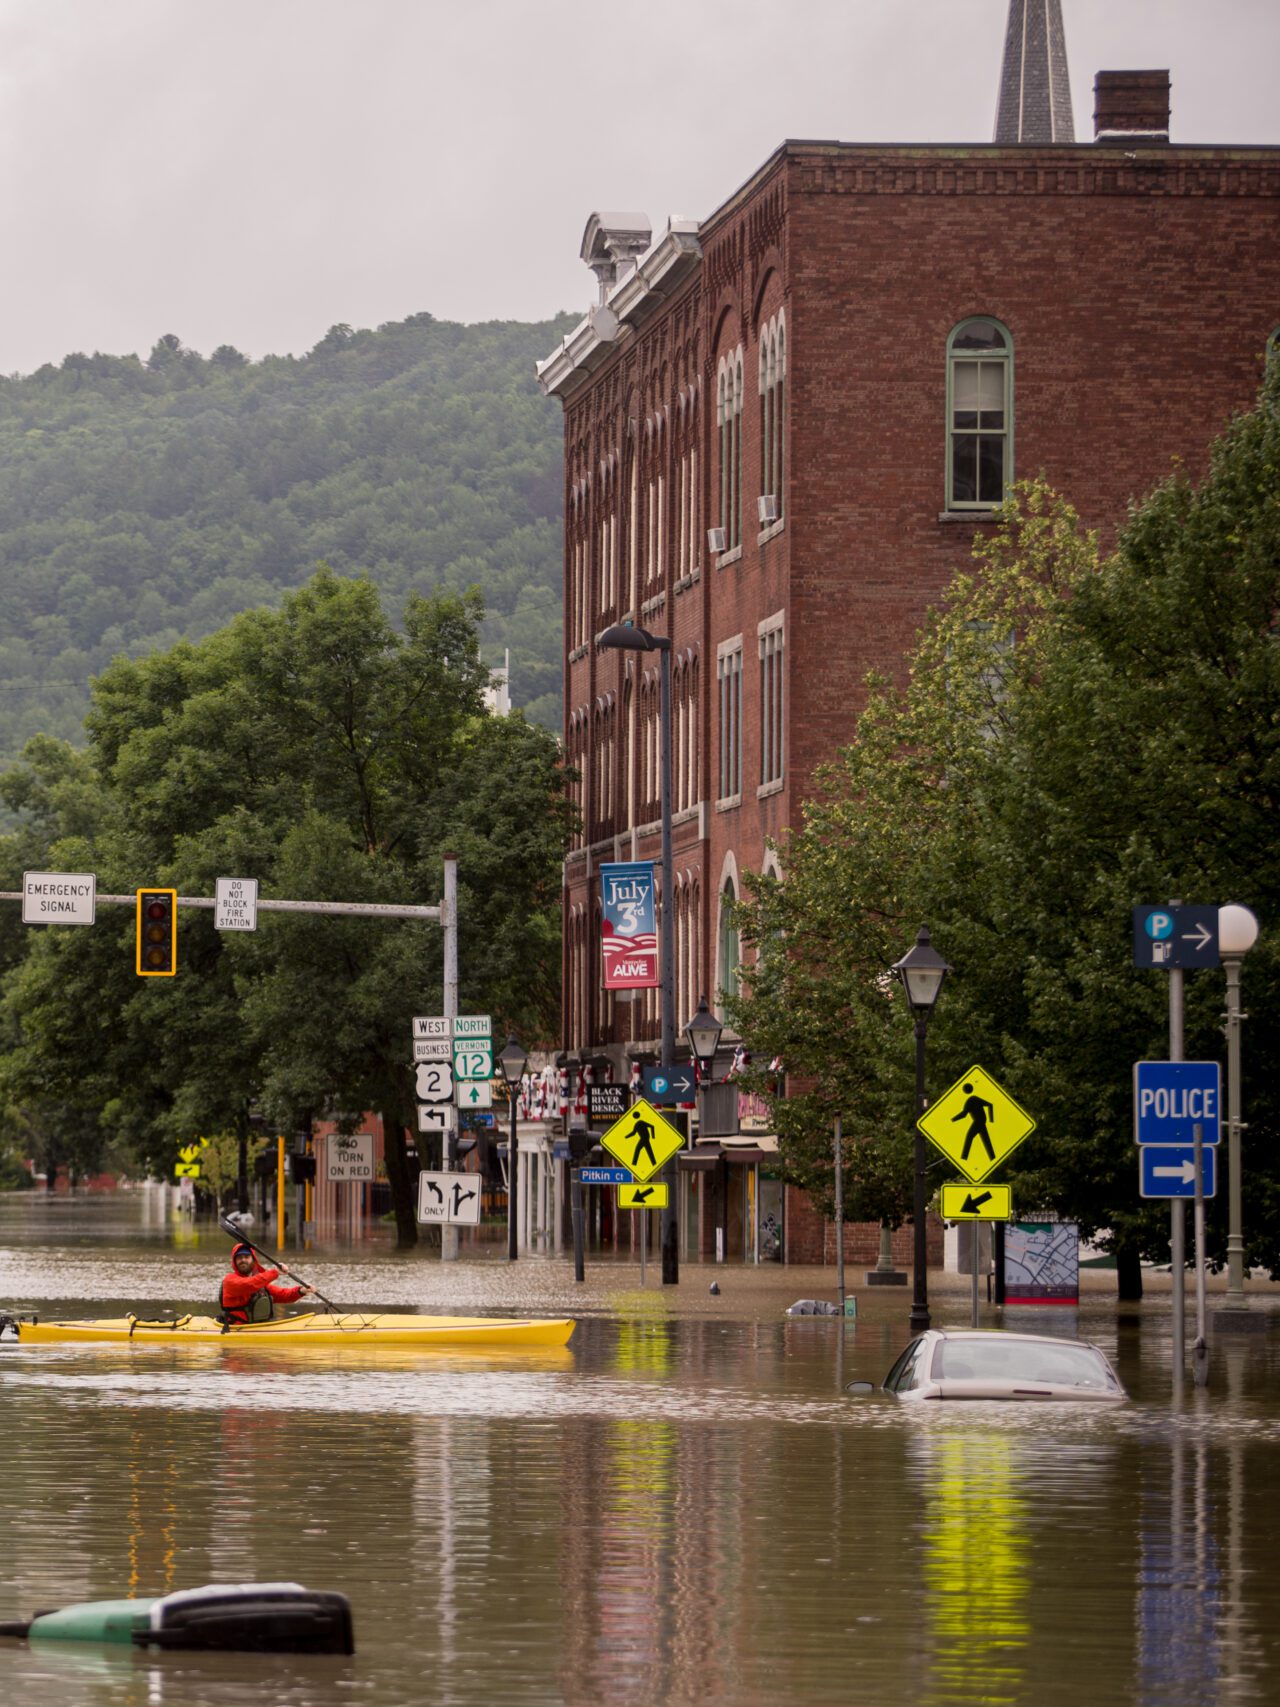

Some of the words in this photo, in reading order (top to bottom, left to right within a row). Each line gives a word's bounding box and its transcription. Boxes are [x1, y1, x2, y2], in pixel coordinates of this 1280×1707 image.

[27, 884, 91, 897] EMERGENCY
[231, 881, 242, 890] DO
[228, 890, 244, 899] NOT
[607, 880, 650, 906] July
[40, 901, 77, 913] SIGNAL
[223, 900, 248, 909] BLOCK
[227, 909, 244, 918] FIRE
[617, 902, 645, 933] 3rd
[220, 918, 251, 928] STATION
[1152, 915, 1168, 937] P
[613, 964, 648, 977] ALIVE
[419, 1021, 446, 1033] WEST
[456, 1019, 488, 1032] NORTH
[416, 1045, 450, 1055] BUSINESS
[456, 1042, 488, 1050] VERMONT
[462, 1054, 485, 1076] 12
[427, 1071, 441, 1092] 2
[655, 1078, 665, 1092] P
[591, 1087, 623, 1096] BLACK
[591, 1096, 620, 1104] RIVER
[1140, 1088, 1216, 1119] POLICE
[591, 1104, 625, 1113] DESIGN
[337, 1153, 364, 1163] TURN
[330, 1166, 345, 1176] ON
[349, 1166, 370, 1176] RED
[582, 1170, 610, 1181] Pitkin
[615, 1172, 624, 1180] Ct
[424, 1207, 445, 1216] ONLY
